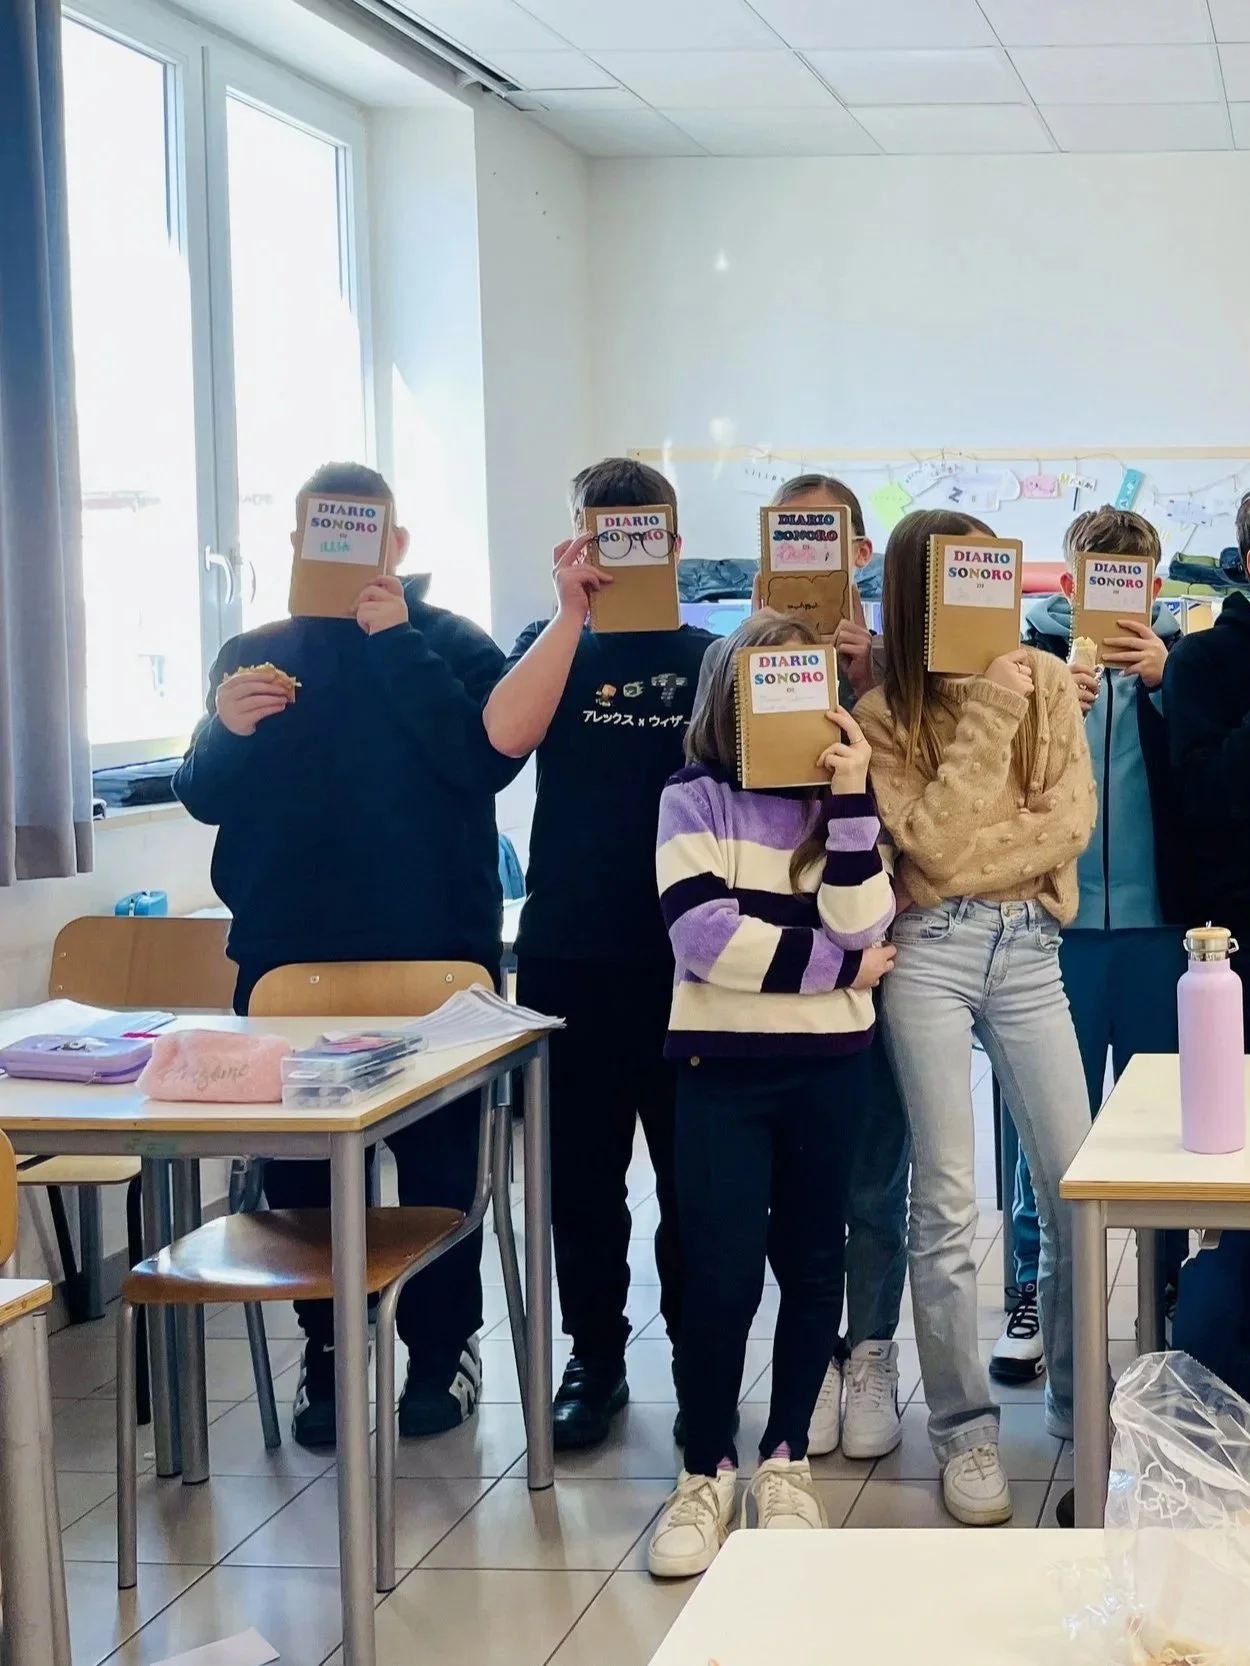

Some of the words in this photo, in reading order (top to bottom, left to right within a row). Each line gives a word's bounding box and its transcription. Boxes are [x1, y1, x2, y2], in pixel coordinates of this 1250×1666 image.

[317, 503, 376, 518] DIARIO
[311, 517, 377, 533] SONORO
[605, 516, 659, 527] DIARIO
[778, 514, 834, 525] DIARIO
[773, 530, 838, 542] SONORO
[954, 550, 1010, 564] DIARIO
[948, 567, 1013, 581] SONORO
[1094, 563, 1142, 575] DIARIO
[1089, 576, 1144, 589] SONORO
[759, 655, 819, 667] DIARIO
[754, 671, 824, 685] SONORO
